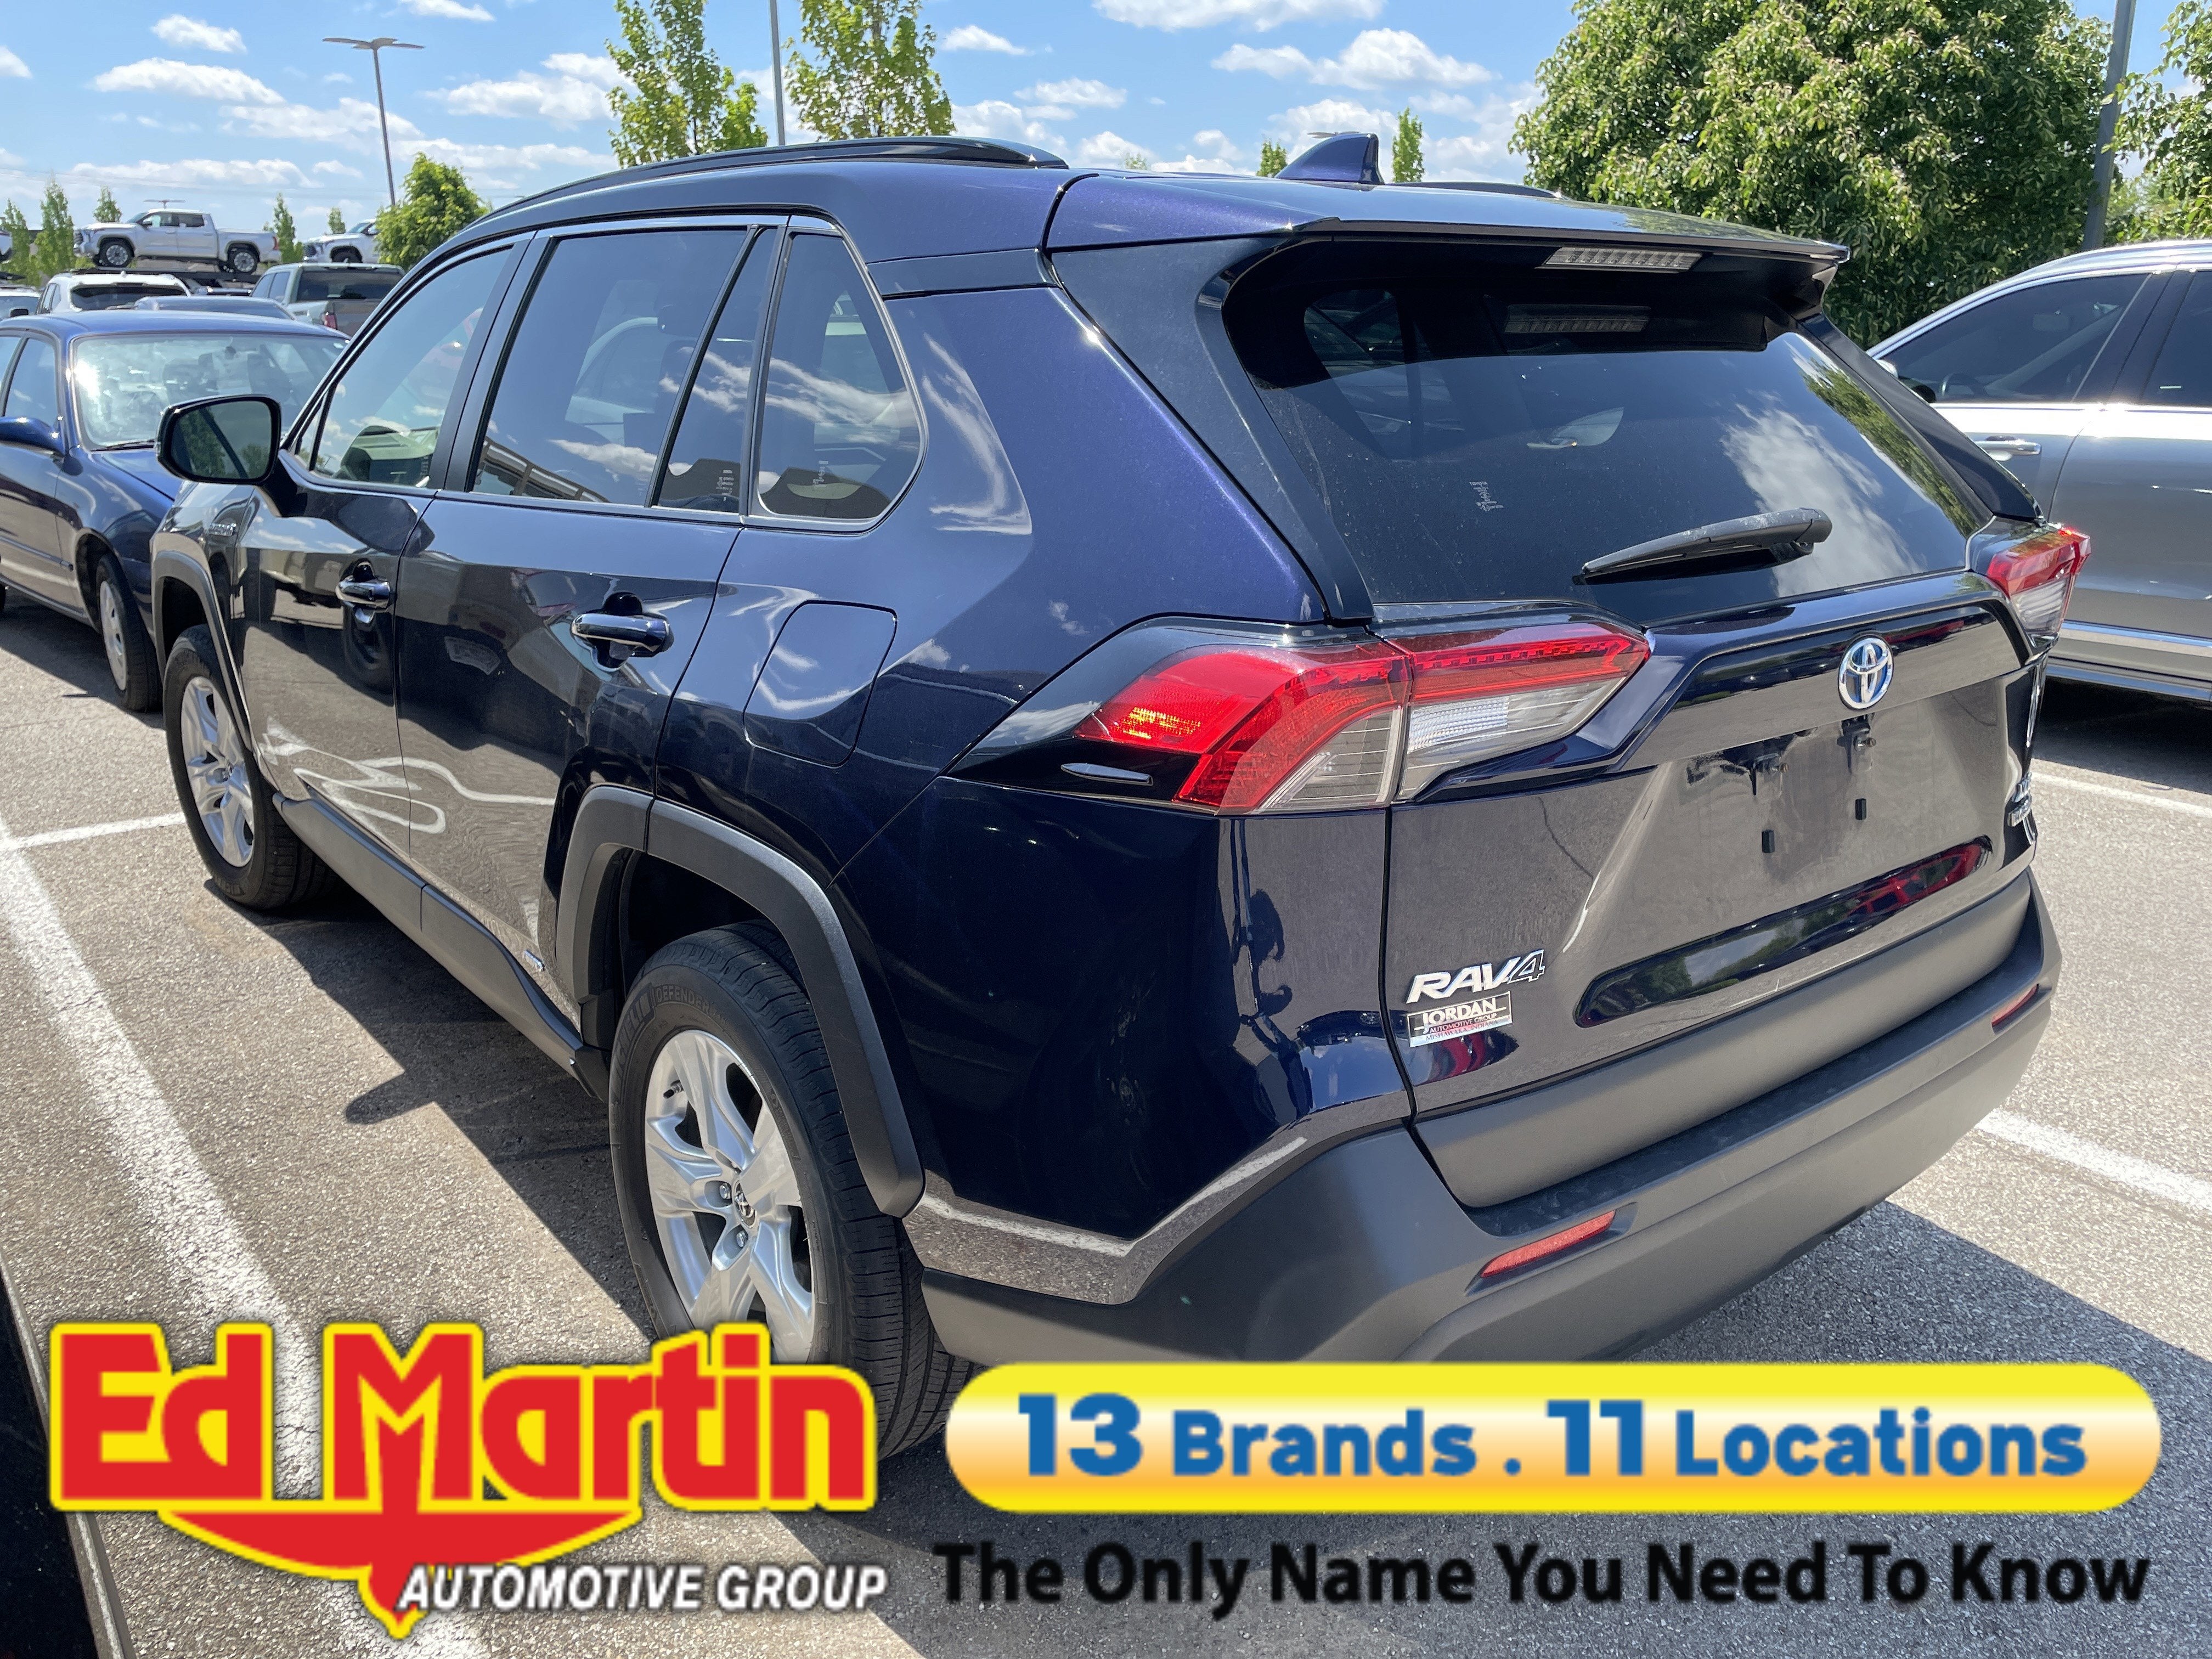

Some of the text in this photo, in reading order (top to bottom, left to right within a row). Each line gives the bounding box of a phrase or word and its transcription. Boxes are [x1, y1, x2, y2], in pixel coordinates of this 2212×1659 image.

[1406, 949, 1545, 1003] RAV4
[1423, 997, 1497, 1034] JORDAN
[1430, 1013, 1497, 1032] AUTOMOTIVE GROUP
[1471, 1019, 1498, 1030] INDIANA
